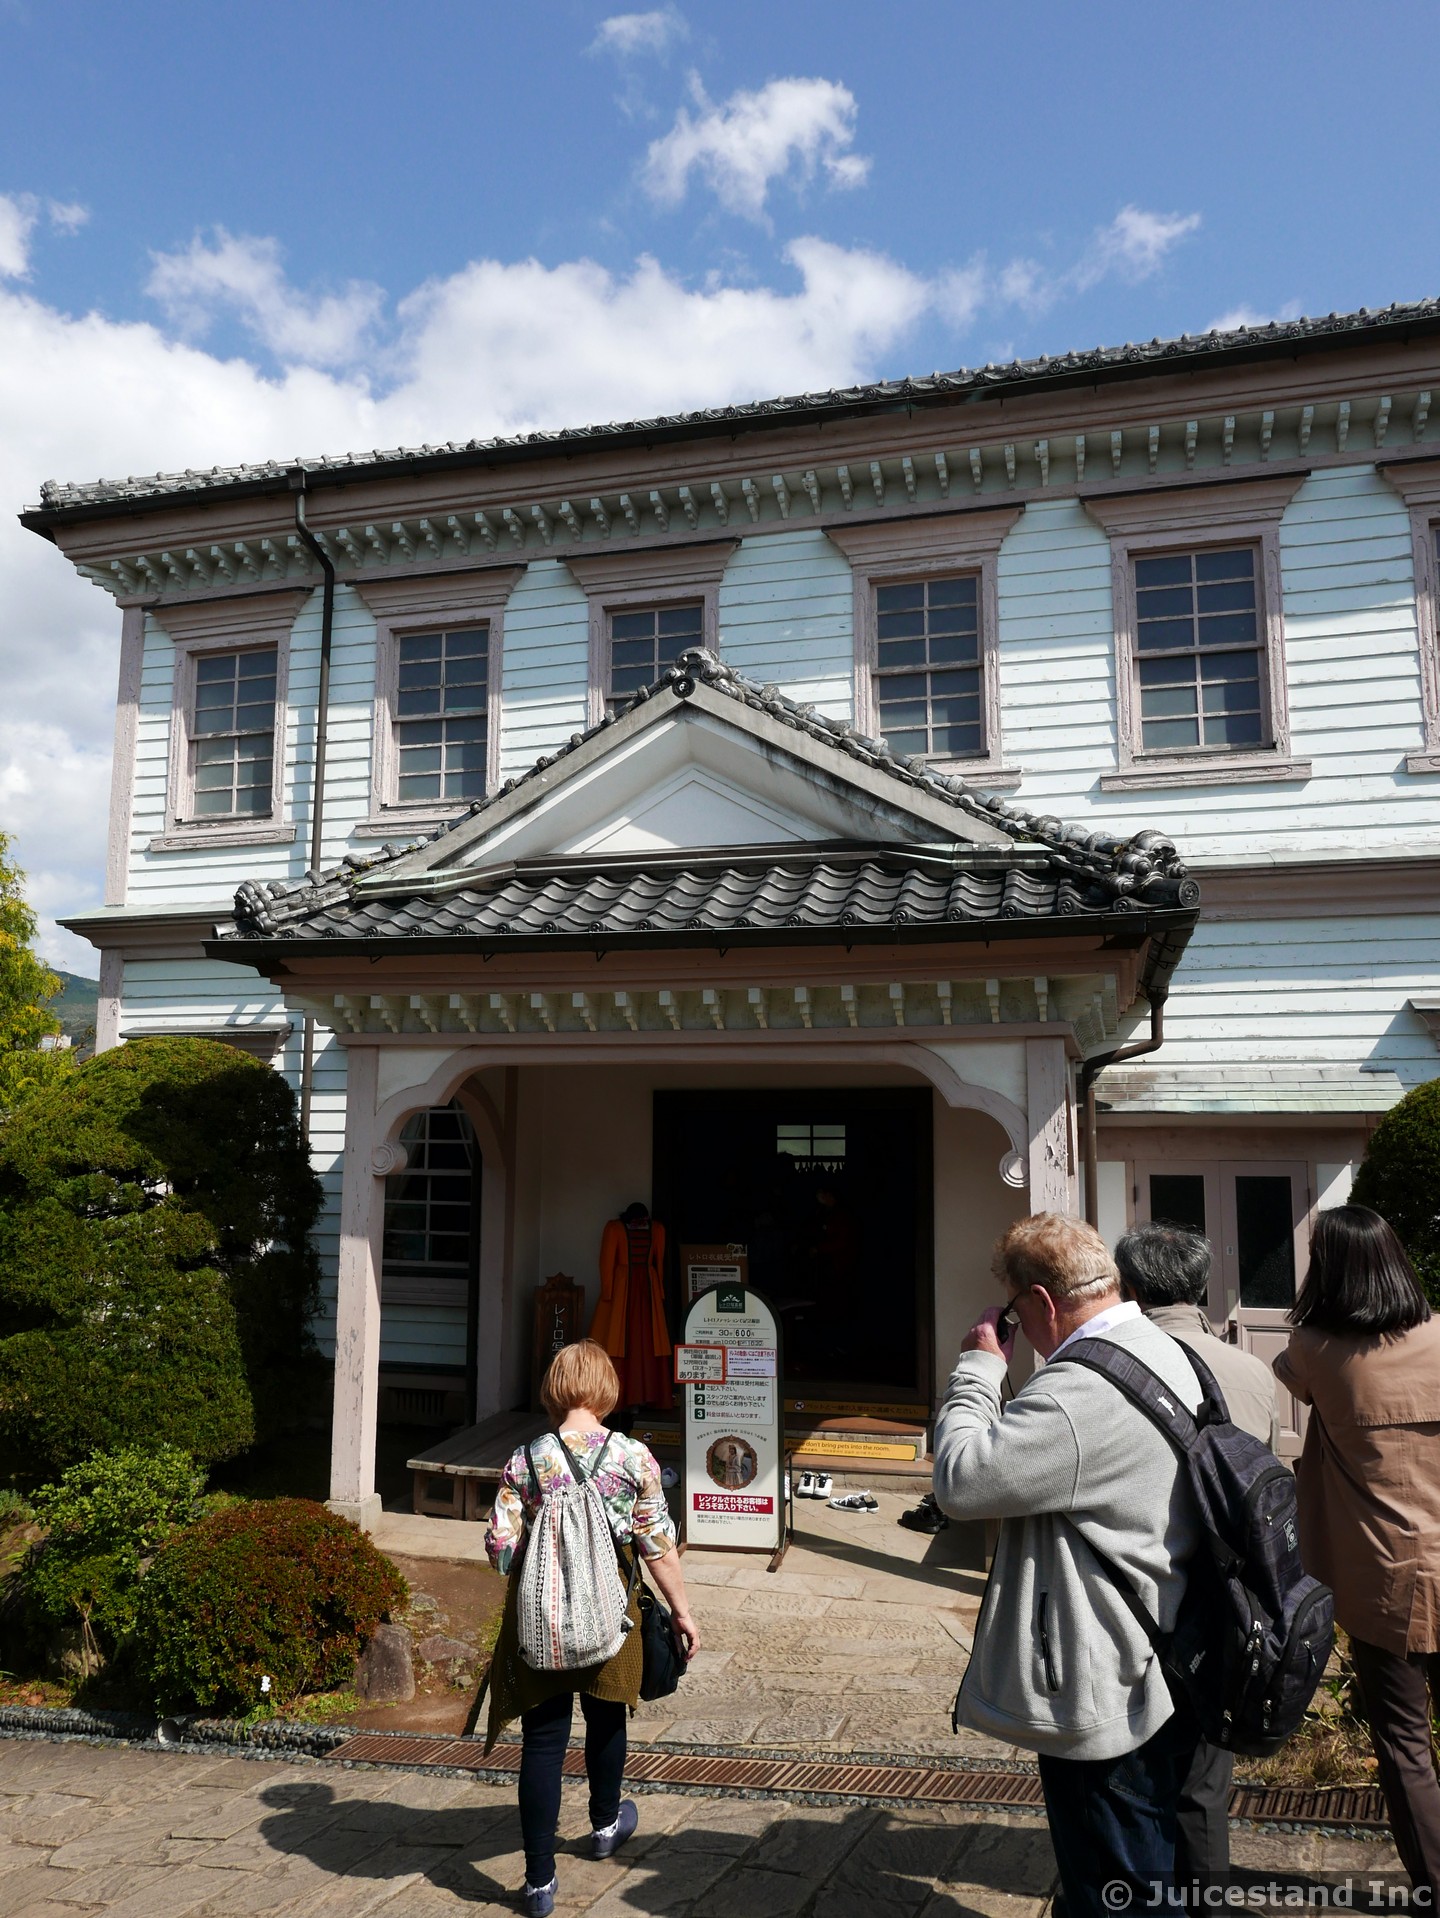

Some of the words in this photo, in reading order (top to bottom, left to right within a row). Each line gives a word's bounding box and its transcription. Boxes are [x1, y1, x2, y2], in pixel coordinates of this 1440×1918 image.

[706, 1394, 767, 1402] スタッフがご案内いたします
[698, 1495, 769, 1505] レンタルされるお客様は
[698, 1502, 759, 1512] どうぞお入り下さい。
